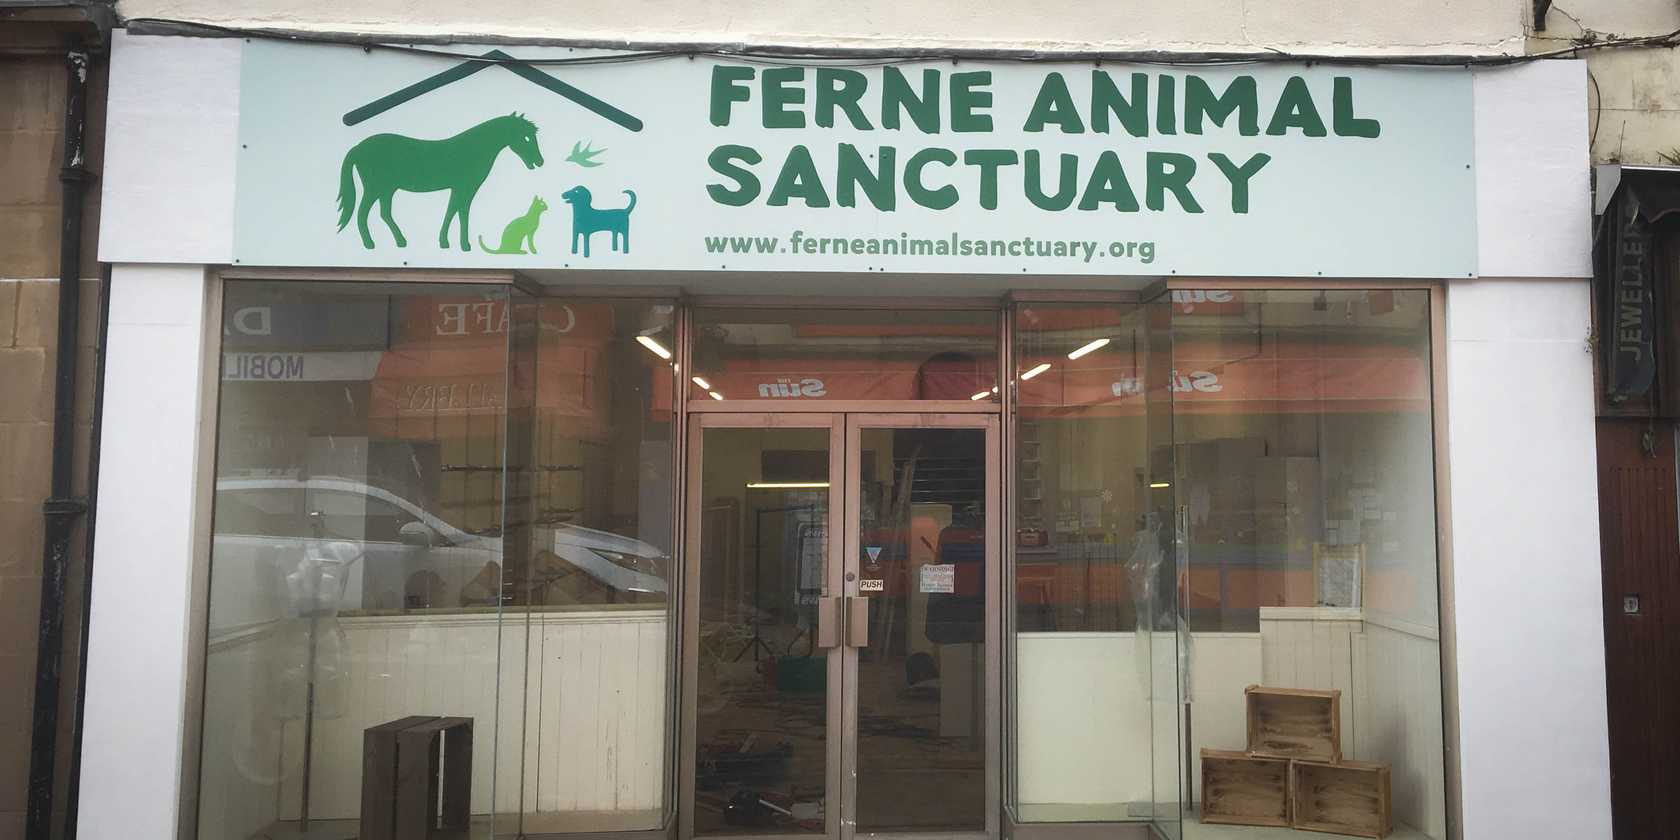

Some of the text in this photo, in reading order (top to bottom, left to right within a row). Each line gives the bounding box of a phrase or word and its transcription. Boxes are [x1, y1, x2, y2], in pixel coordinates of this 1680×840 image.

[708, 64, 1382, 139] FERNE ANIMAL
[706, 143, 1271, 214] SANCTUARY
[704, 230, 1156, 264] www.ferneanimalsanctuary.org
[860, 580, 883, 589] PUSH
